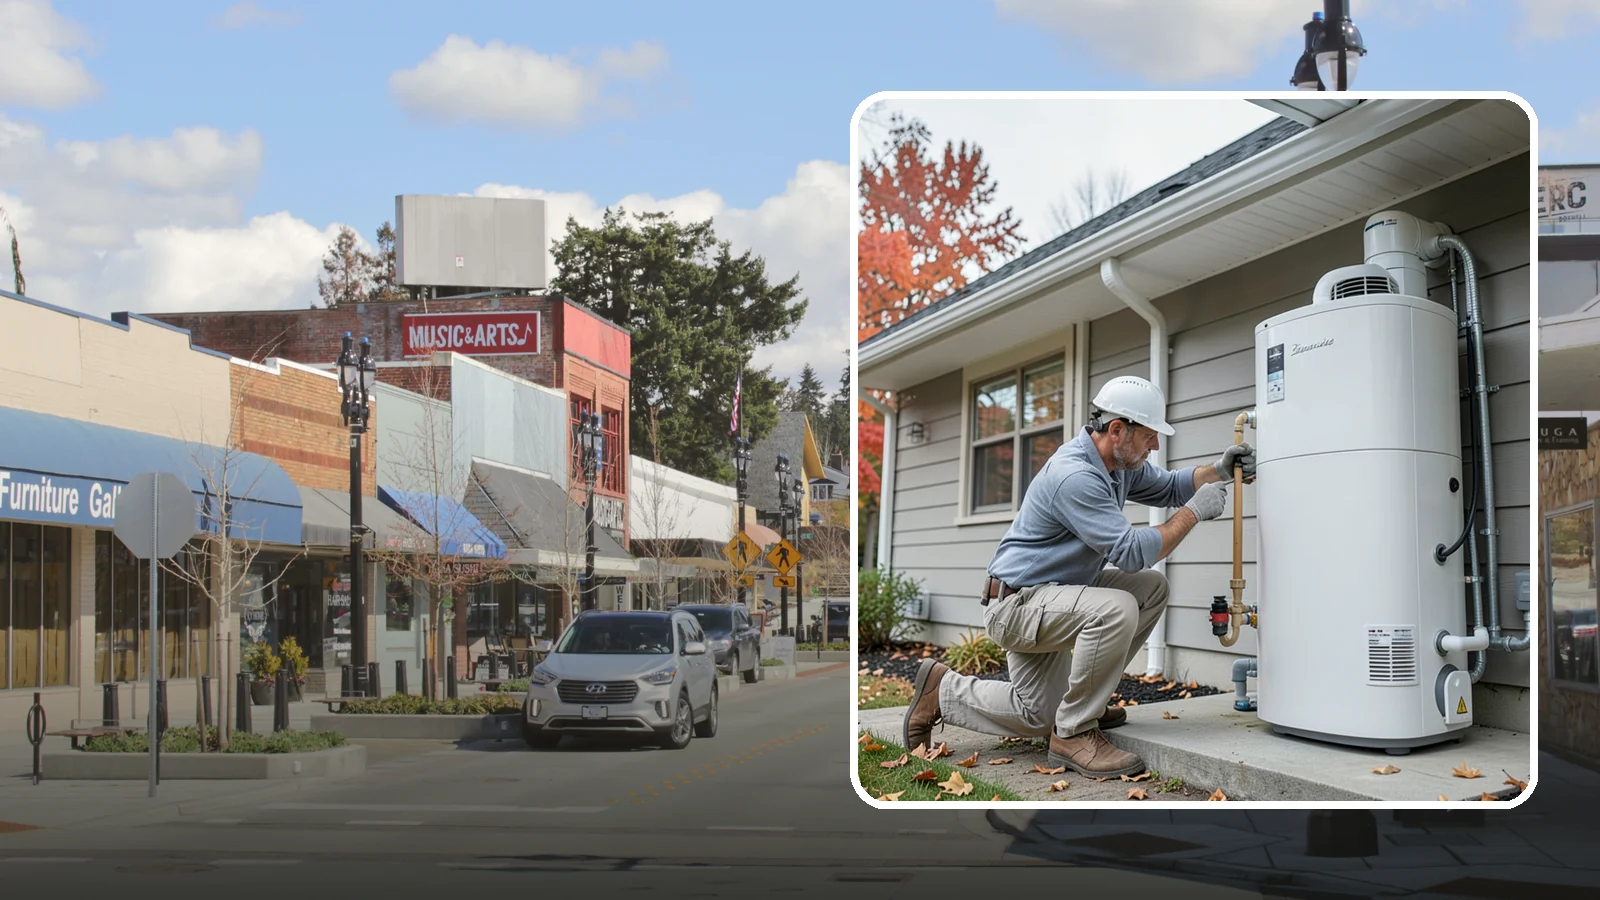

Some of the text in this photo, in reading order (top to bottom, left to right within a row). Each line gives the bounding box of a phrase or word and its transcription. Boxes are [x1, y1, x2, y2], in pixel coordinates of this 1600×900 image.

[1540, 428, 1577, 436] UGA
[0, 471, 121, 519] Furniture Gal
[453, 563, 479, 574] SUSHI
